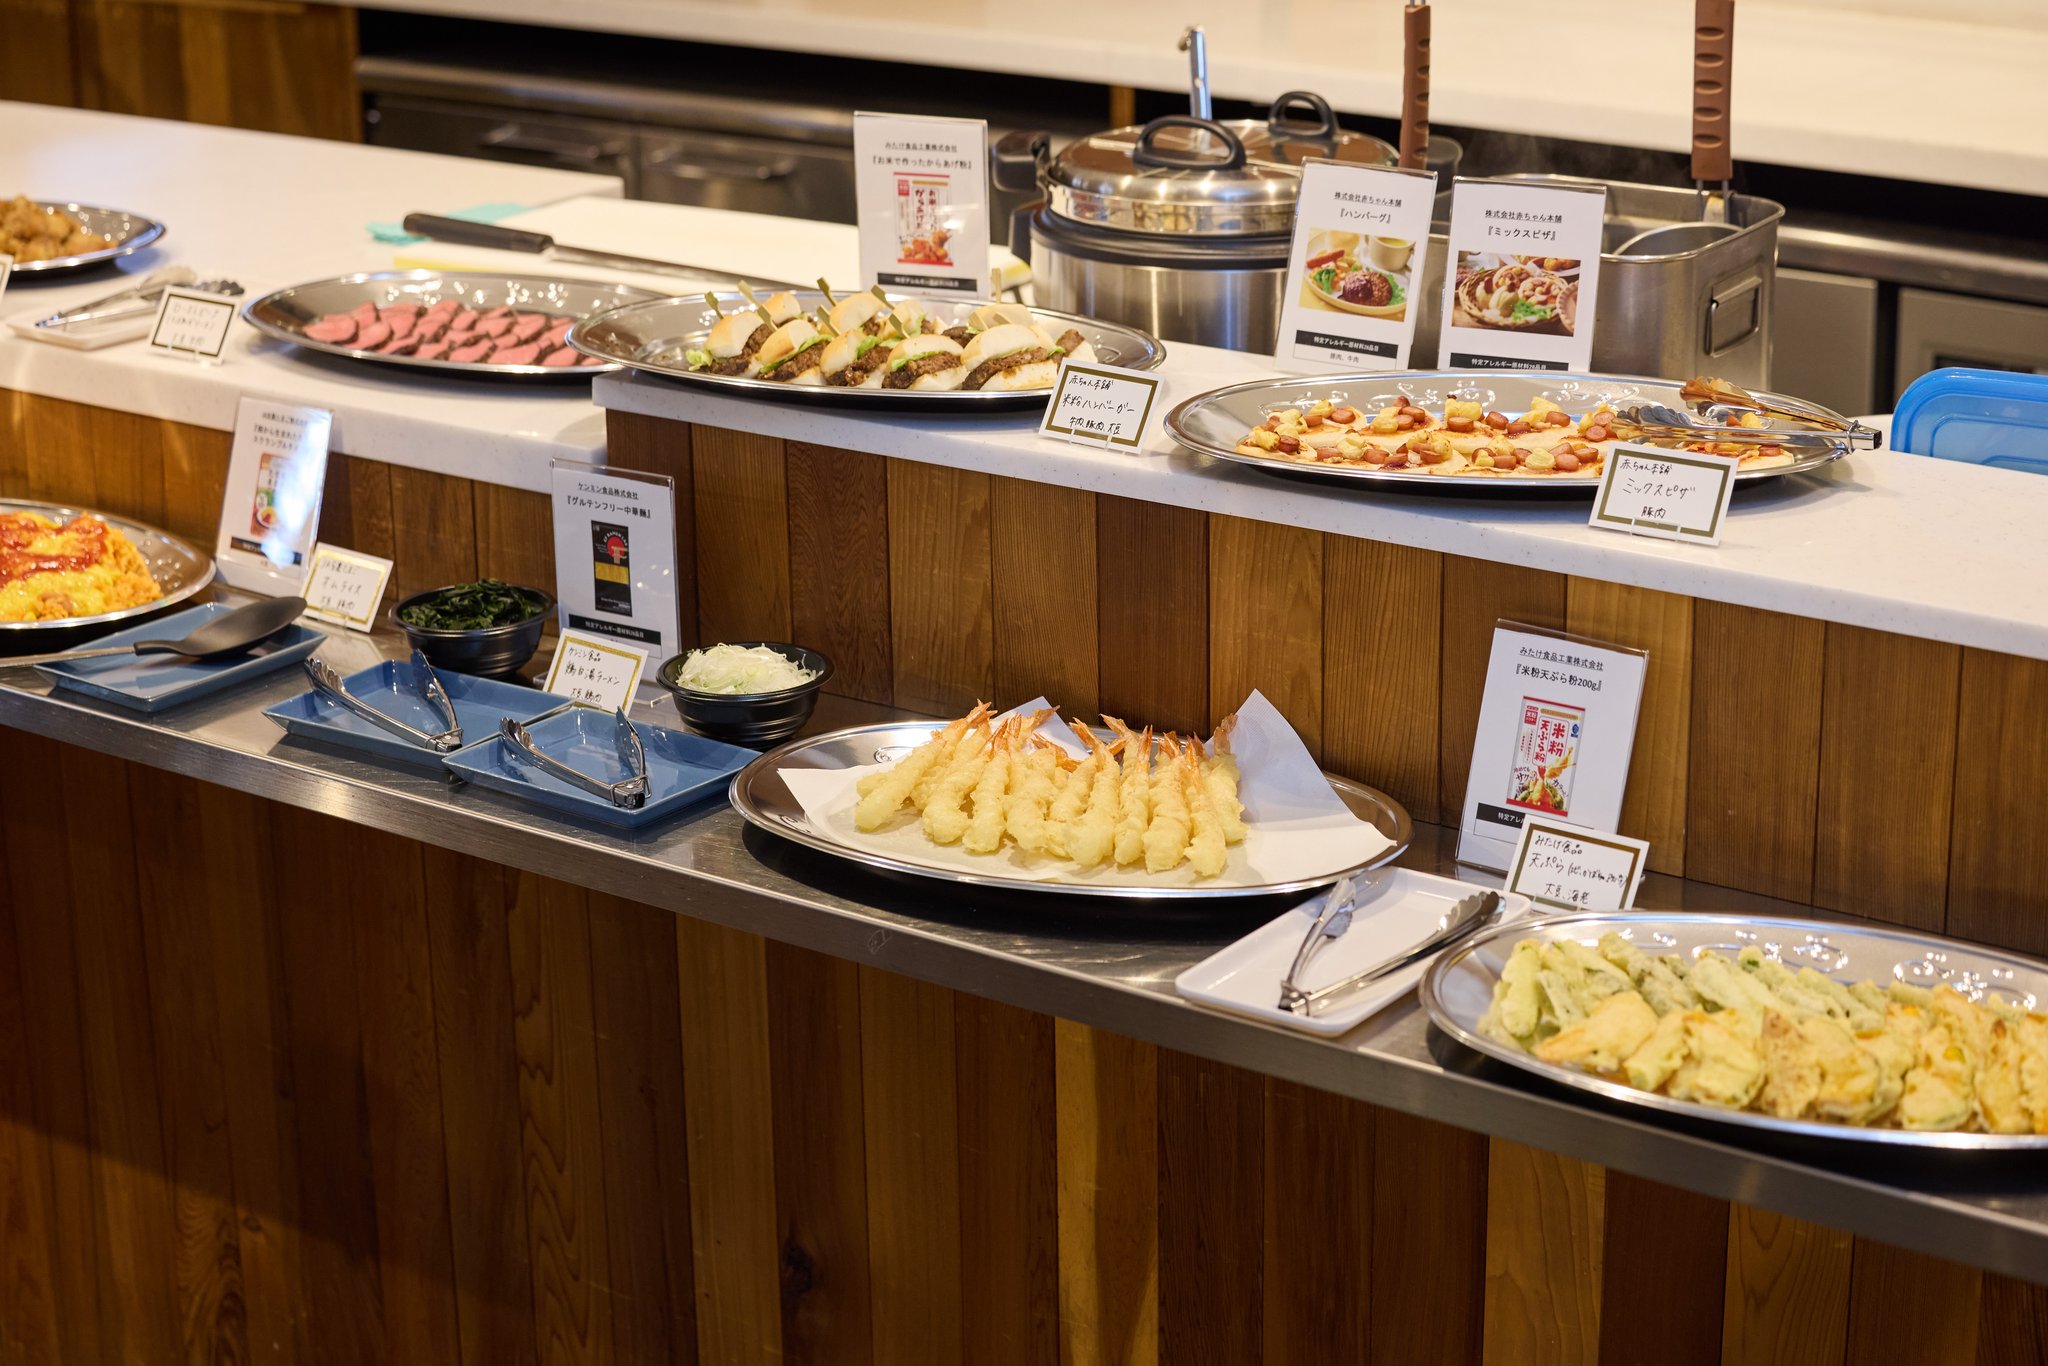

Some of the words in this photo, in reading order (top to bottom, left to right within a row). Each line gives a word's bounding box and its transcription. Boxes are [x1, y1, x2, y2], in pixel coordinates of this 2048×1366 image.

[1334, 191, 1402, 208] 株式会社赤ちゃん本舗
[1340, 208, 1392, 224] 『ハンバーグ』
[1485, 209, 1563, 224] 株式会社赤ちゃん本舗
[1488, 226, 1556, 241] 『ミックスピザ』
[1314, 336, 1380, 352] 特定アレルギー原材料28品目
[1069, 375, 1114, 390] 赤ちゃん本舗
[1062, 393, 1135, 414] 米粉ハンバーガー
[1620, 459, 1673, 475] 赤ちゃん本舗
[577, 482, 639, 500] ケンミン食品株式会社
[1622, 477, 1696, 500] ミックスピザ
[1641, 506, 1667, 519] 豚肉
[568, 647, 601, 662] ケンミン食品
[1520, 646, 1604, 672] みたけ食品工業株式会社
[565, 661, 620, 687] 鶏白湯ラーメン
[1515, 663, 1602, 692] 『米粉天ぷら粉200g』
[1534, 719, 1551, 763] 天ぷら粉
[1547, 722, 1566, 757] 米粉
[1535, 835, 1583, 855] みたけ食品
